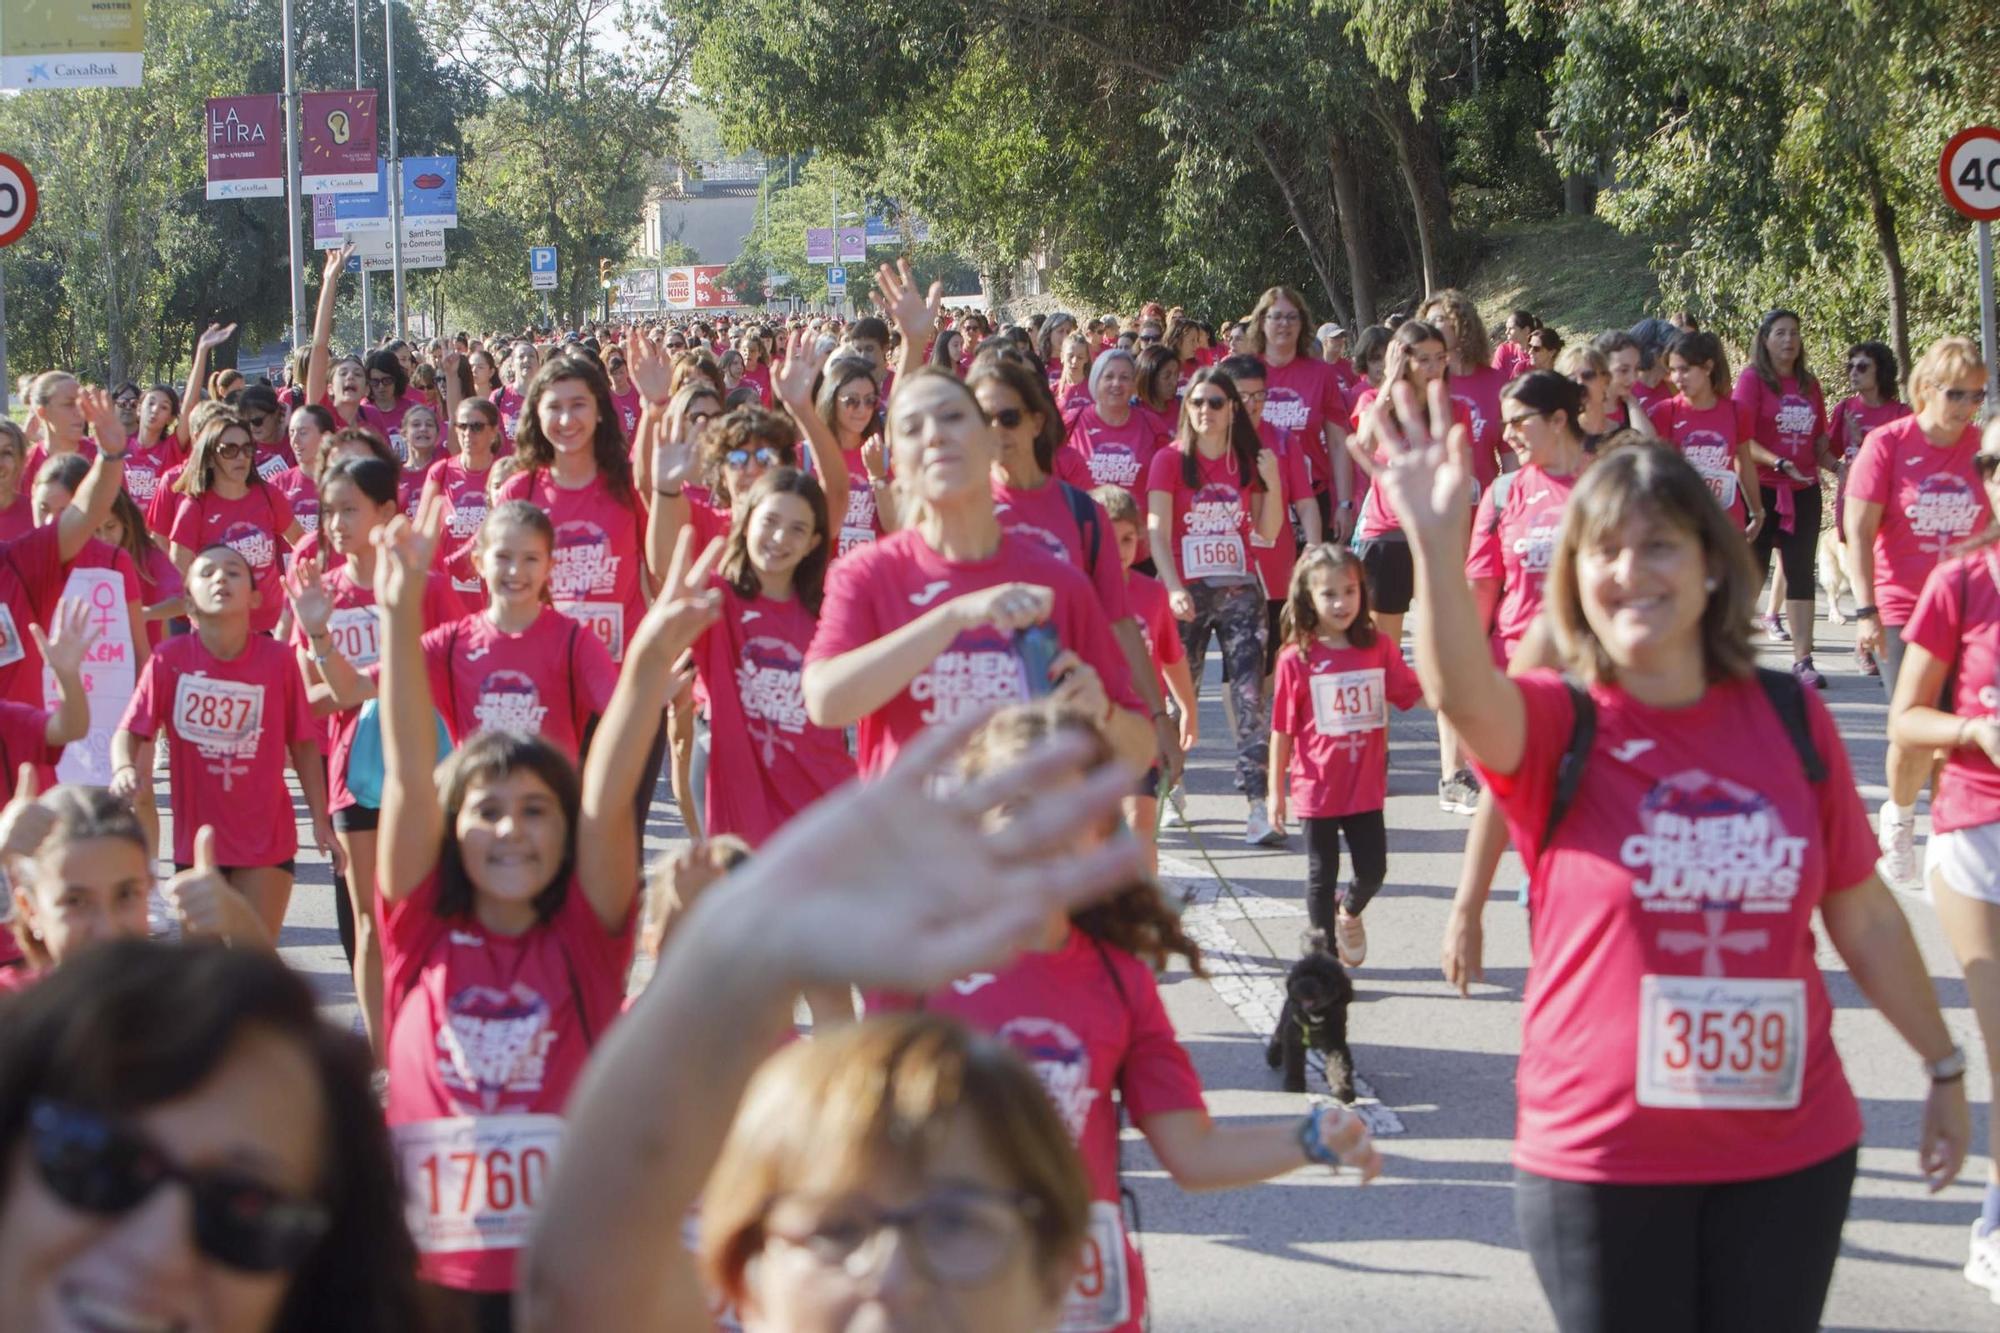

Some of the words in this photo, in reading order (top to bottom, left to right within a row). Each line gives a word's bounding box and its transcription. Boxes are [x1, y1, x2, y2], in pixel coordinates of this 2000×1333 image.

[54, 63, 119, 77] CaixaBank
[213, 107, 240, 126] LA
[212, 123, 266, 144] FIRA
[409, 230, 425, 239] Sant
[409, 239, 443, 248] Comercial
[536, 250, 552, 270] P
[831, 270, 843, 283] P
[667, 287, 690, 298] KING
[1193, 541, 1238, 566] 1568
[551, 556, 622, 577] RESCUT
[1333, 684, 1373, 716] 431
[185, 692, 252, 731] 2837
[1652, 810, 1770, 842] #HEM
[1619, 834, 1809, 869] CRESCUT
[1631, 864, 1800, 900] JUNTES
[1663, 1008, 1786, 1073] 3539
[419, 1145, 548, 1217] 1760
